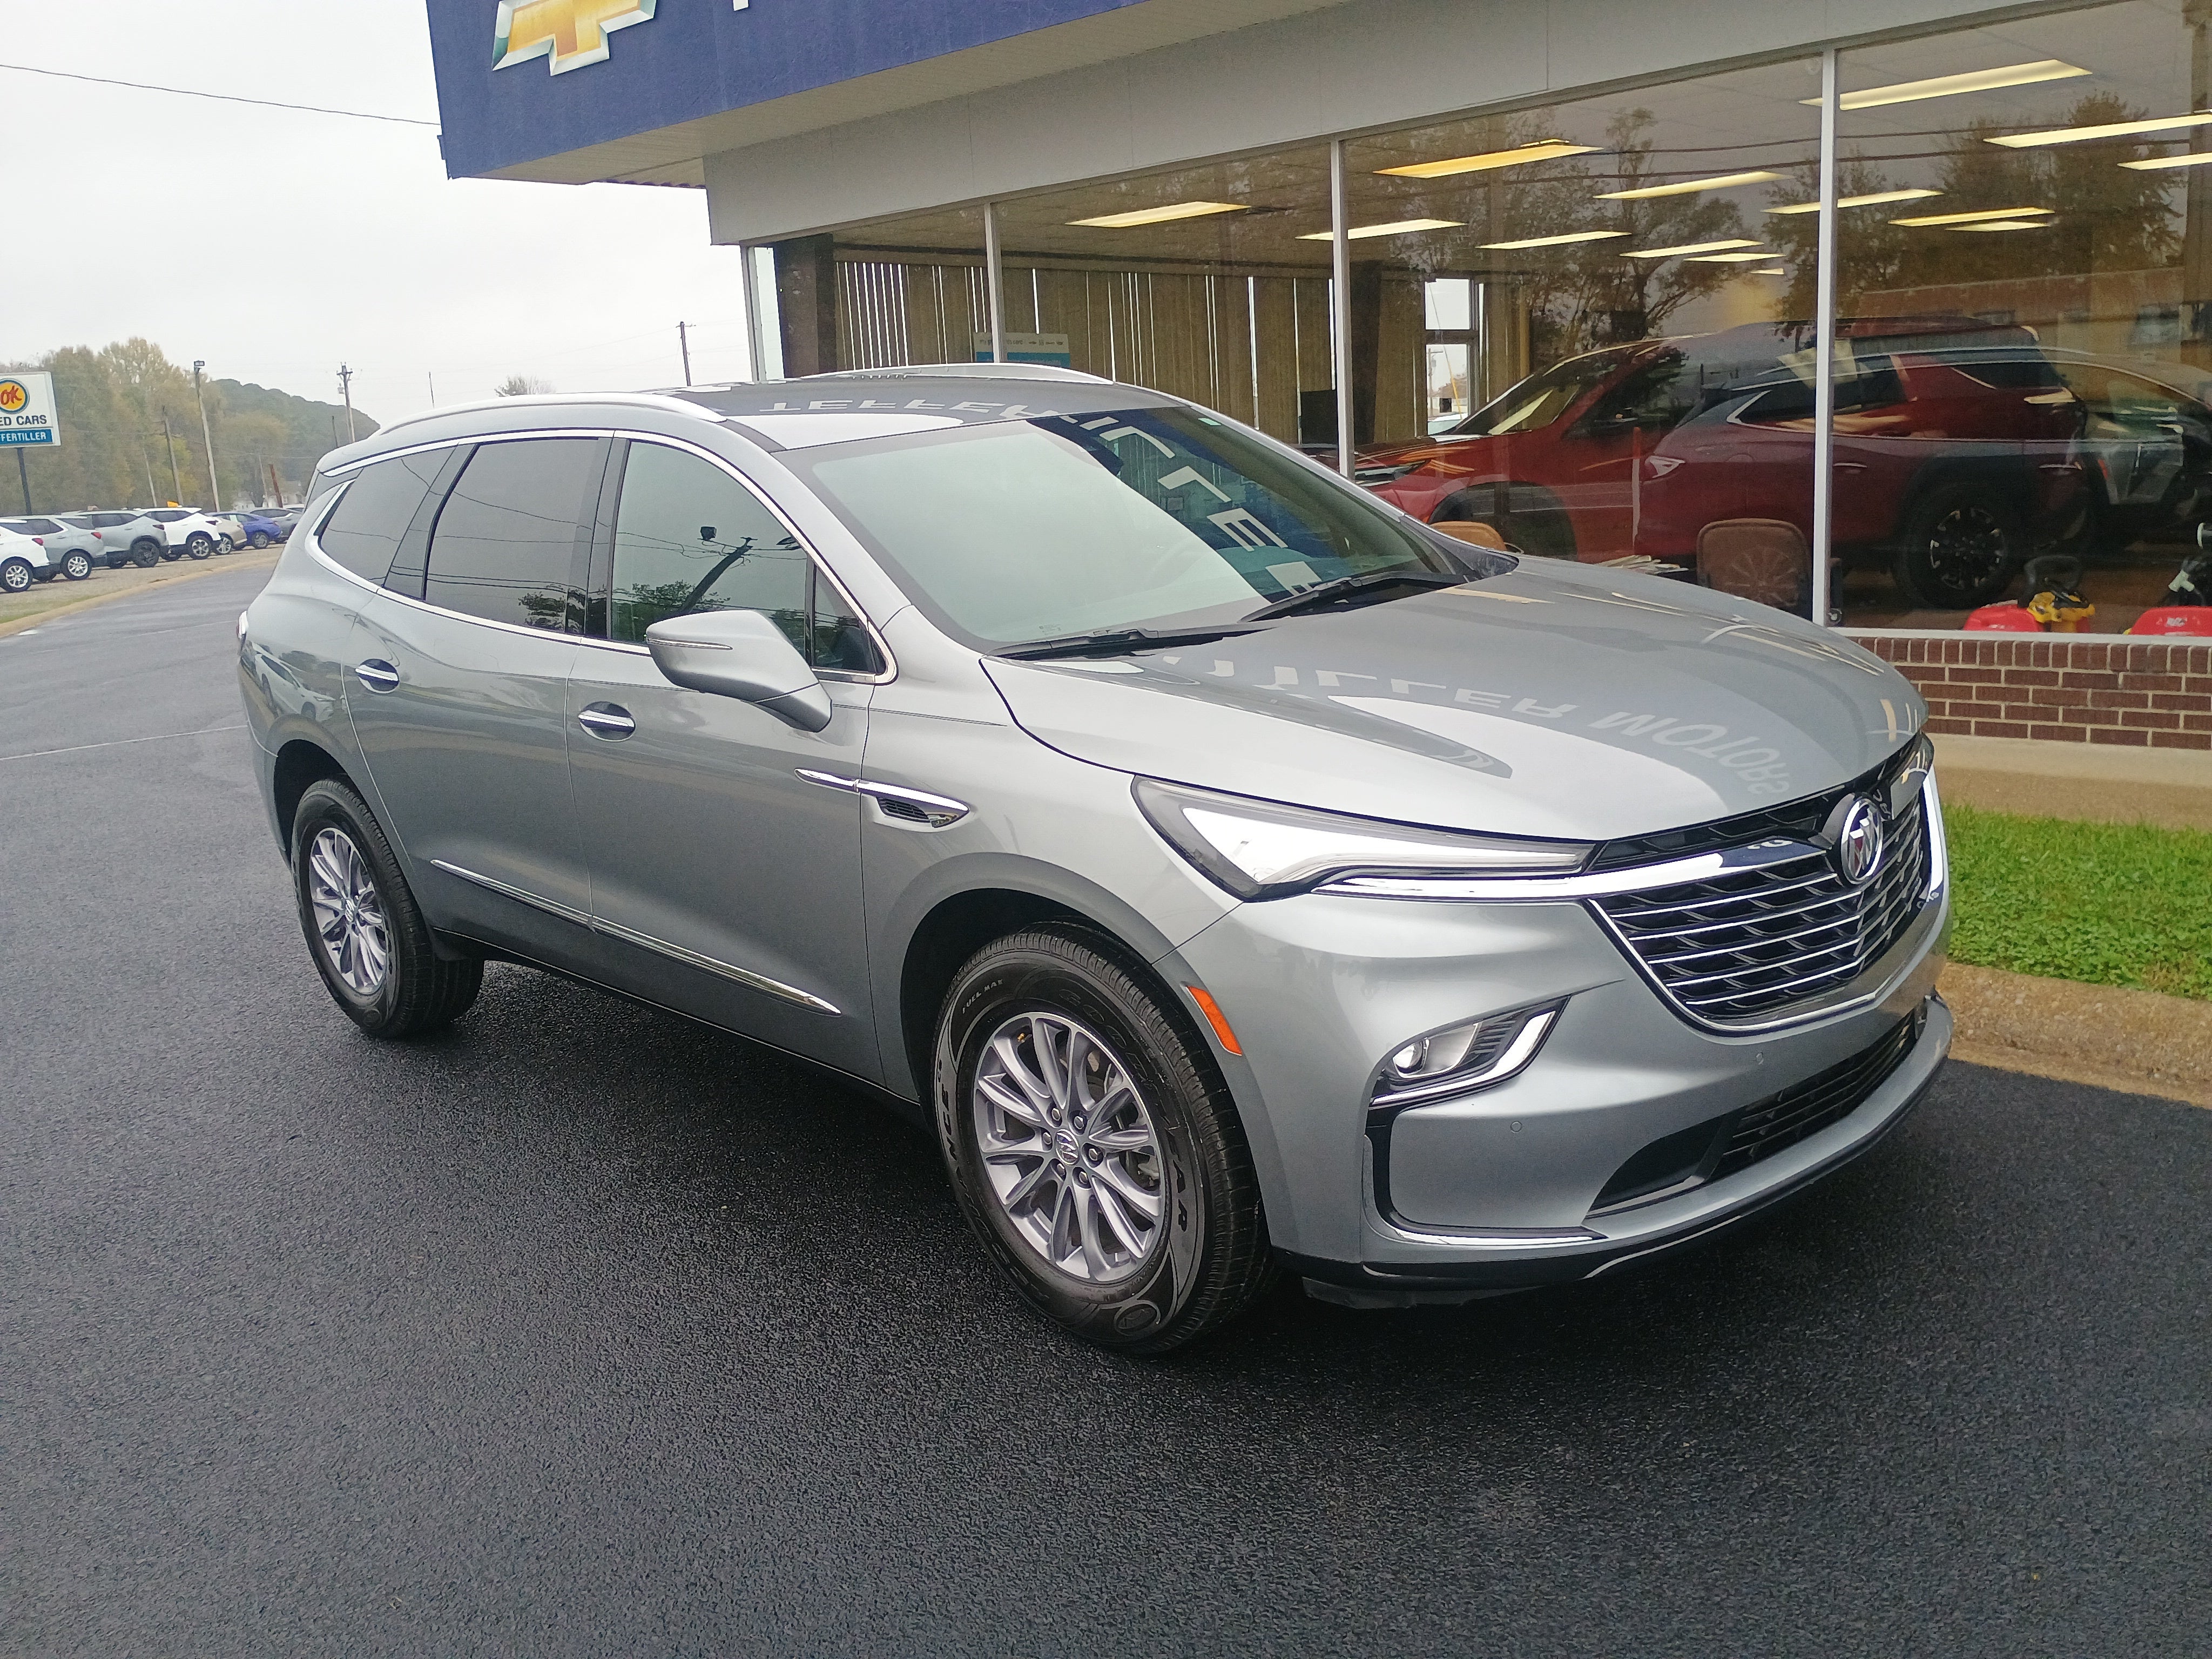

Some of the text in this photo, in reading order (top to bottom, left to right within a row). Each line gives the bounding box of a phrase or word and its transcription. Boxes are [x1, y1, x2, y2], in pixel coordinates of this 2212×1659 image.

[1, 385, 22, 405] OK
[16, 414, 47, 426] CARS
[0, 431, 46, 442] FERTILLER
